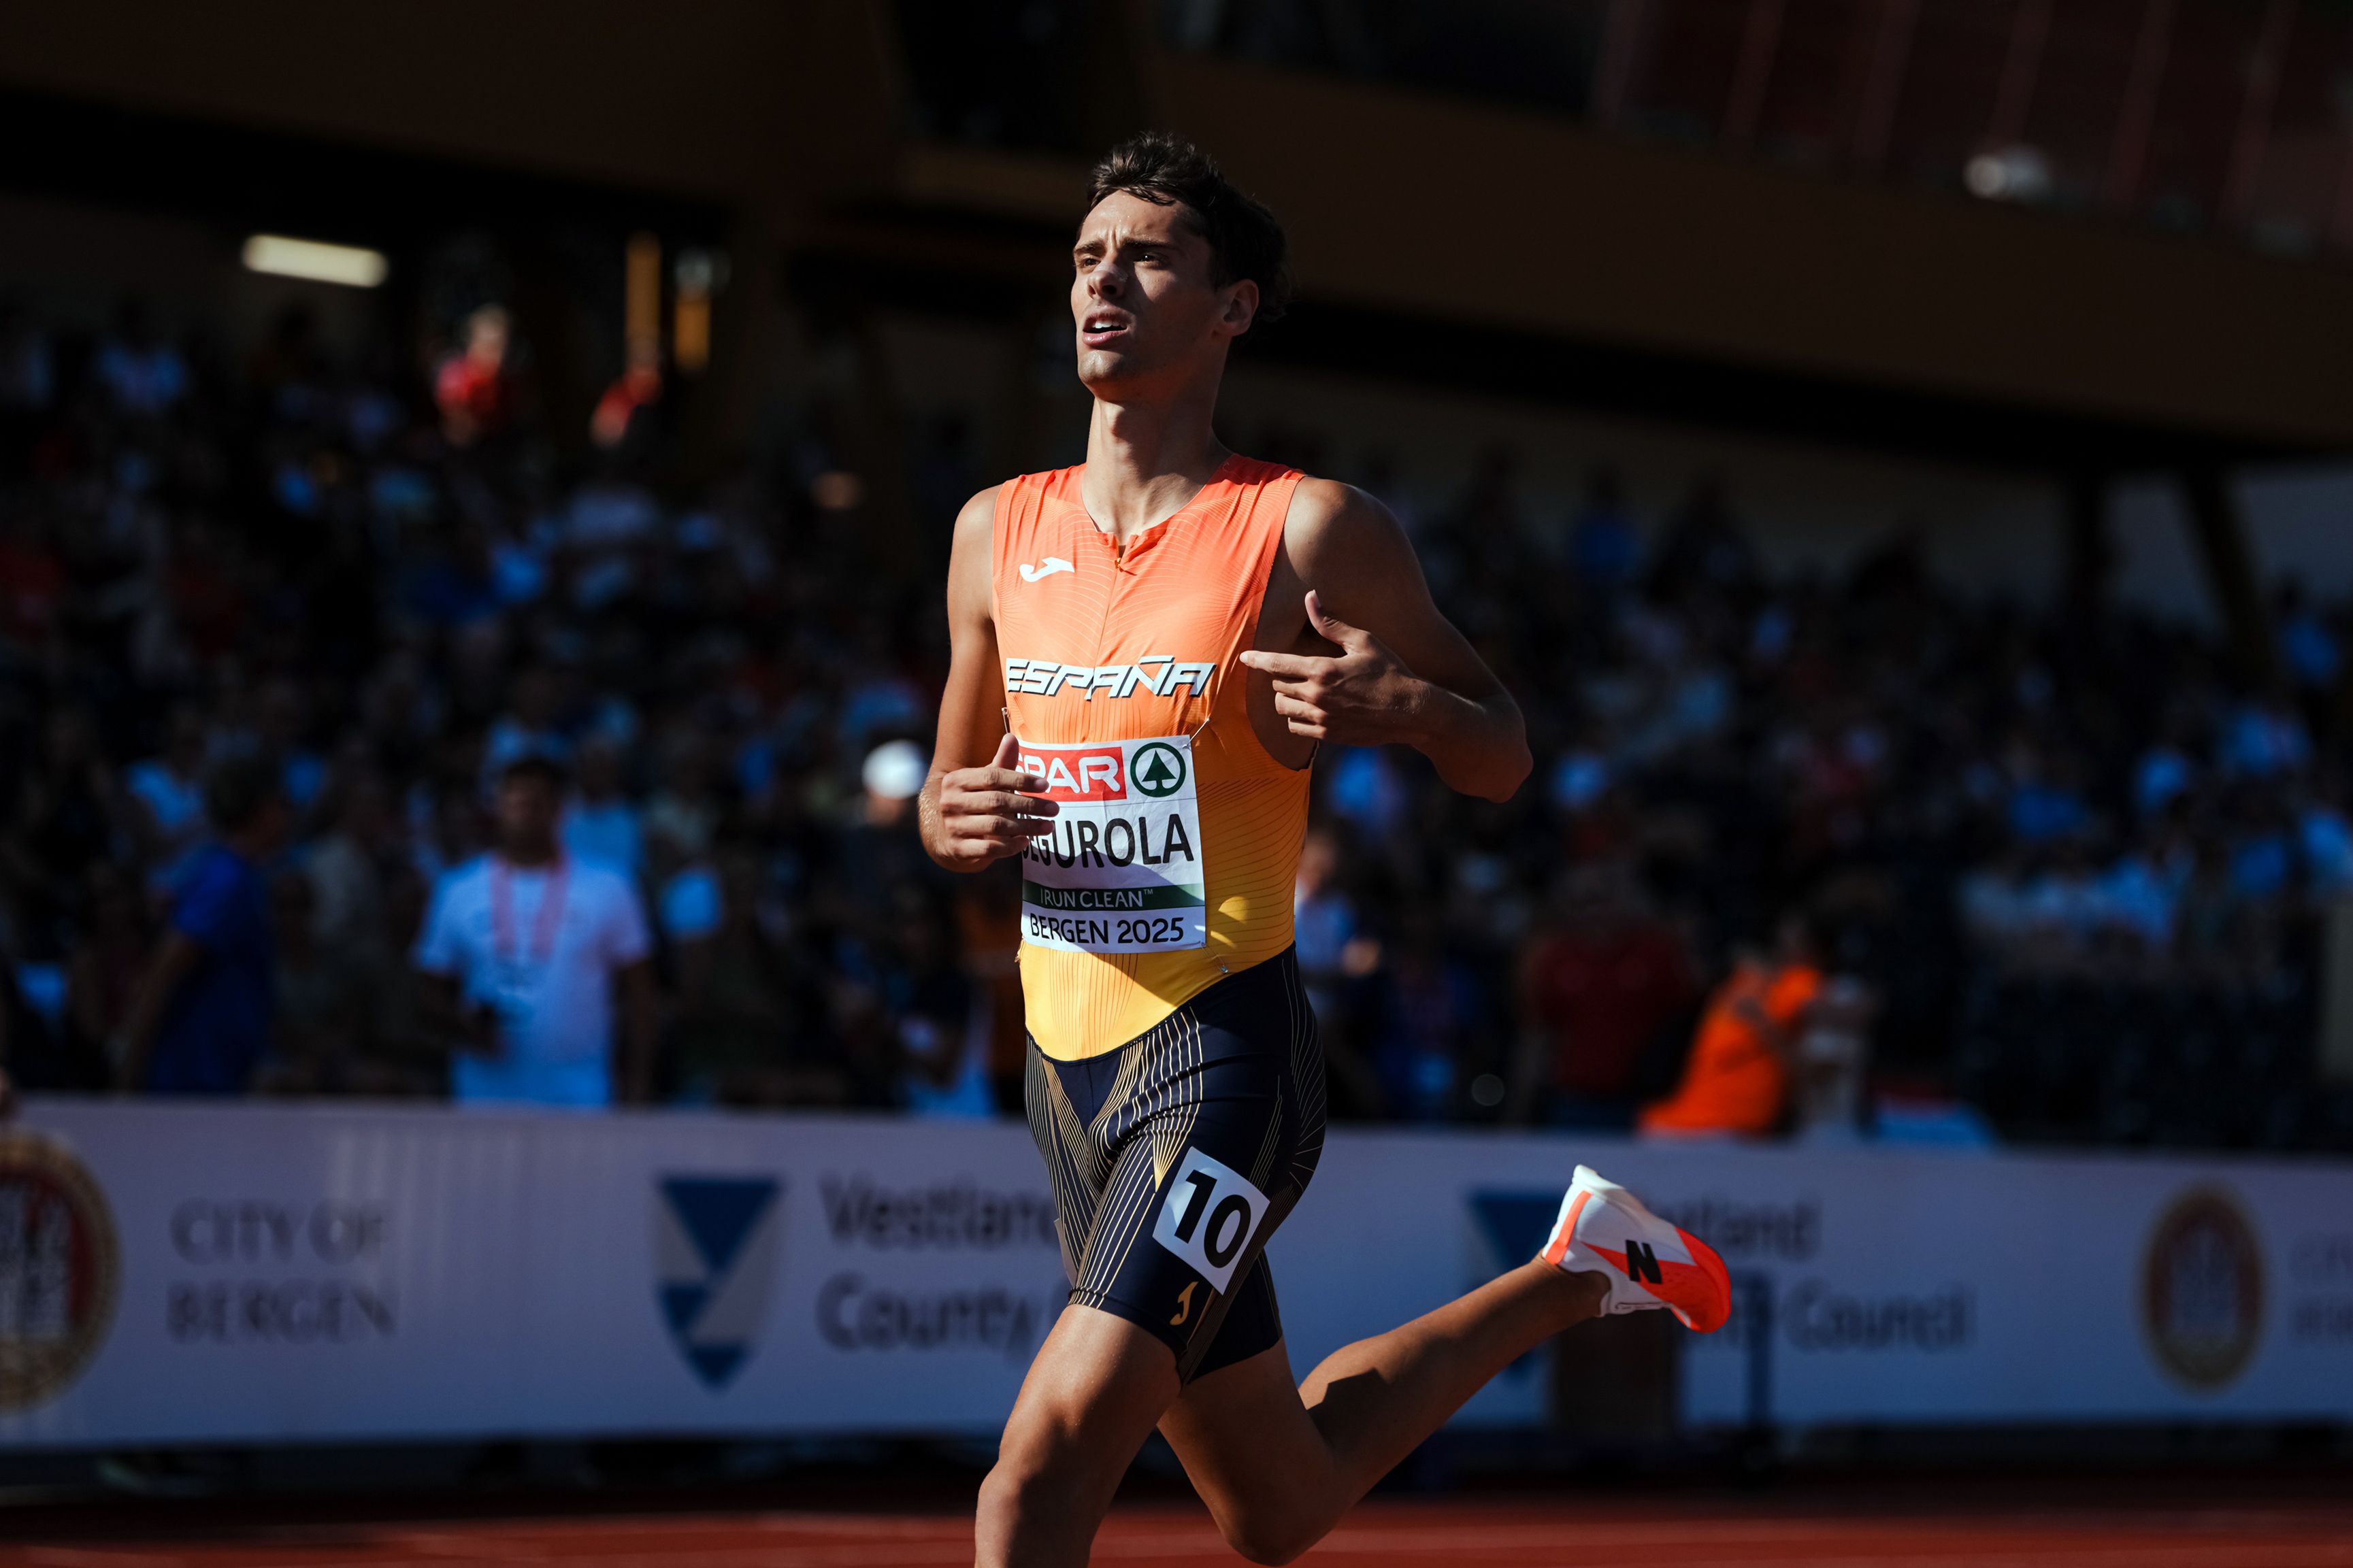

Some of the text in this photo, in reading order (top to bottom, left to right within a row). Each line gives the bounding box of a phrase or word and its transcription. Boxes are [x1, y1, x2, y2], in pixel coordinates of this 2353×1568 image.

[1006, 654, 1217, 701] ESPAÑA
[1016, 754, 1121, 794] PAR
[1030, 913, 1185, 944] BERGEN 2025
[170, 1199, 306, 1265] CITY
[1174, 1169, 1251, 1269] 10
[1626, 1239, 1662, 1284] N
[166, 1279, 399, 1344] BERGEN
